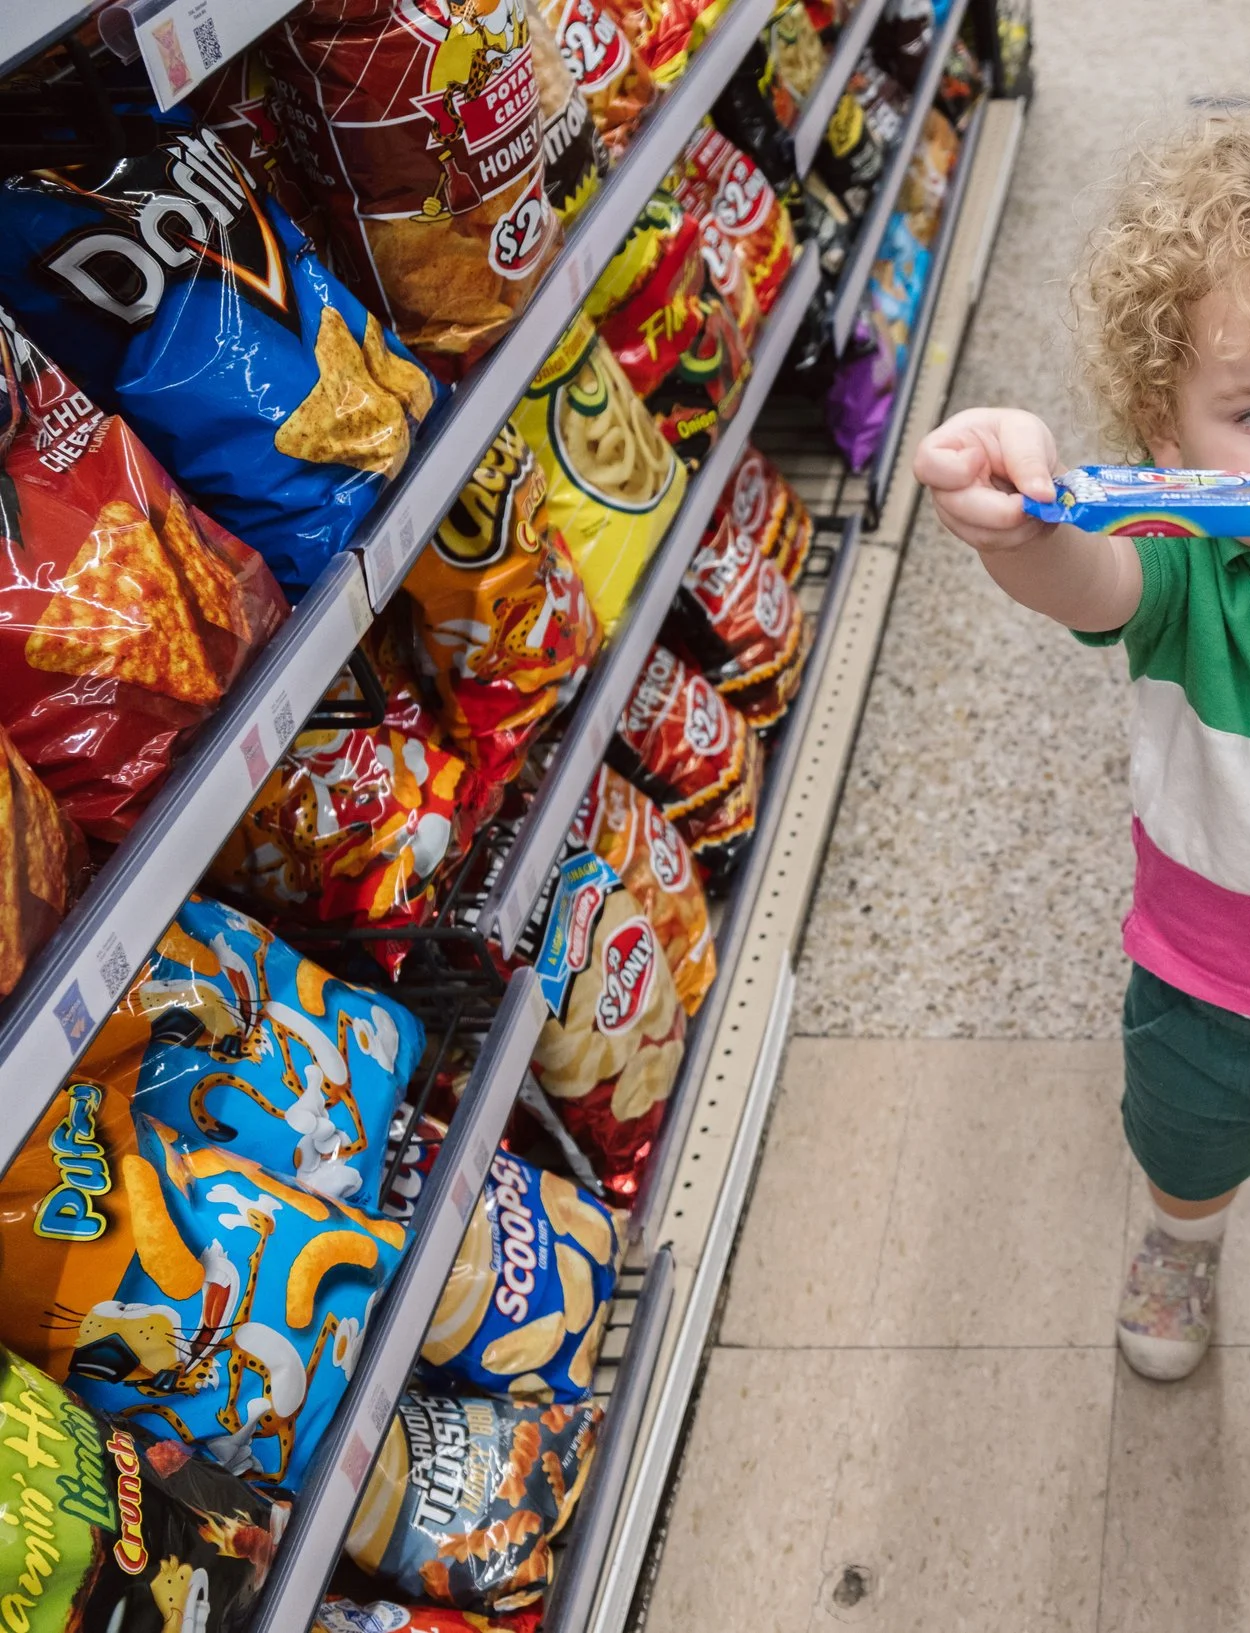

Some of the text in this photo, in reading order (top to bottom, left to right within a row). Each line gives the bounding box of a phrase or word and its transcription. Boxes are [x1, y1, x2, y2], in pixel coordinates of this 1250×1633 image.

[486, 60, 534, 110] POTAT
[494, 79, 537, 124] CRISP
[479, 121, 540, 183] HONEY
[600, 933, 653, 1026] $2 ONLY
[489, 1154, 537, 1324] SCOOPS!
